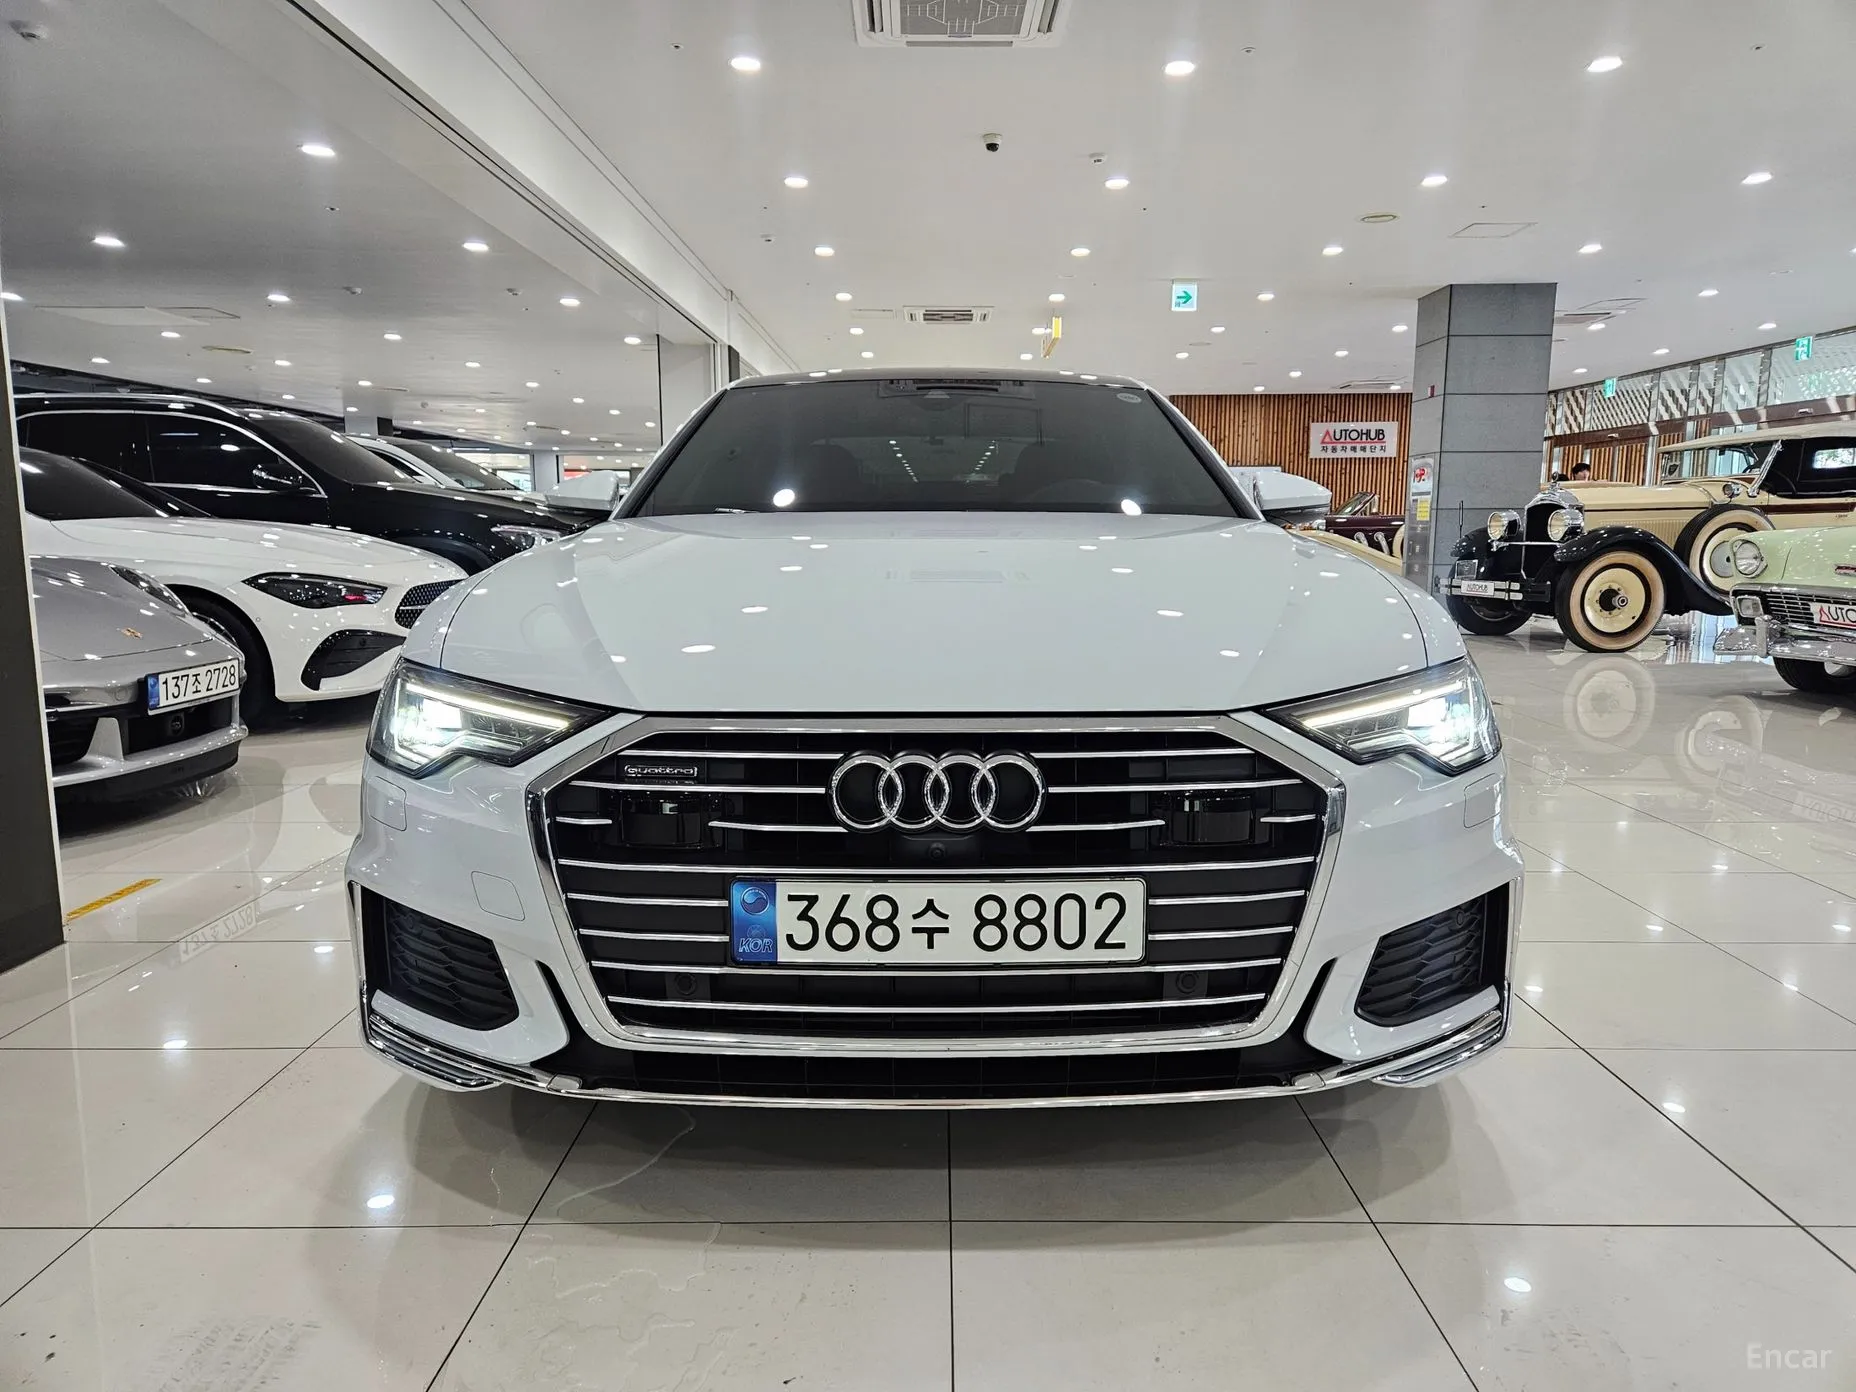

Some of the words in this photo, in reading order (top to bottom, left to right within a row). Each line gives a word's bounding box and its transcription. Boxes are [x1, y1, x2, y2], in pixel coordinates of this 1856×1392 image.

[1320, 428, 1386, 444] AUTOHUB
[1320, 445, 1386, 453] 자동차매매단지
[162, 672, 202, 701] 137조
[205, 664, 236, 692] 2728
[626, 766, 695, 776] quattro
[785, 893, 950, 953] 368수
[972, 891, 1127, 953] 8802
[738, 937, 774, 953] KOR
